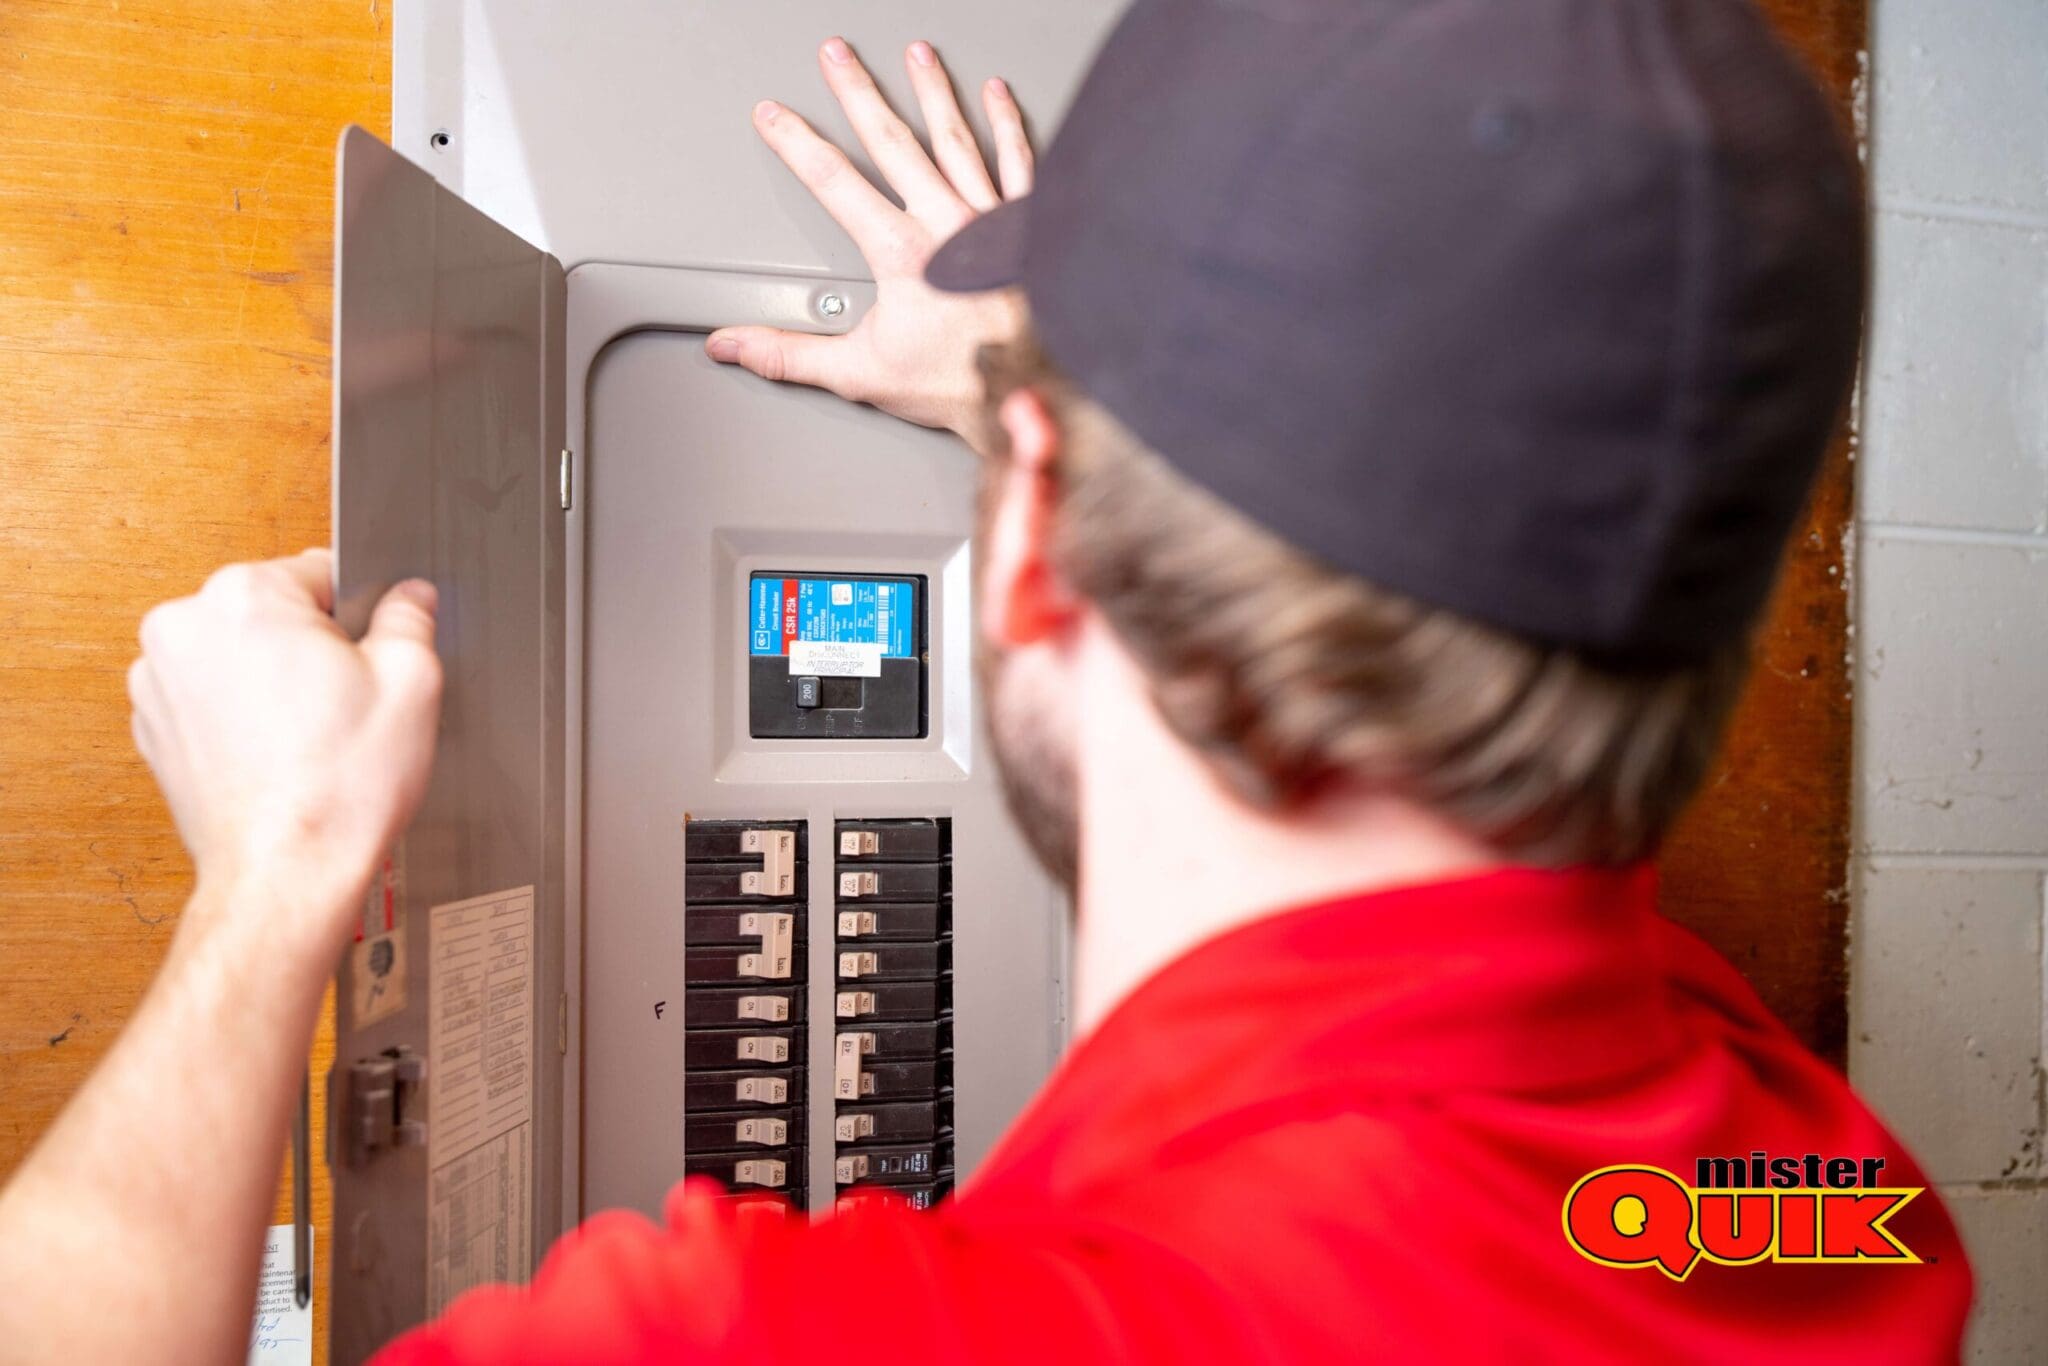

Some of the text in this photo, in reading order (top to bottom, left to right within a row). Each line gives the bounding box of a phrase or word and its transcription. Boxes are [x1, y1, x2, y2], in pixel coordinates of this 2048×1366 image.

[758, 582, 767, 629] Cutler-Hammer
[786, 596, 796, 634] CSR 25k
[803, 684, 812, 700] 200
[750, 835, 756, 846] ON
[749, 876, 756, 886] ON
[844, 880, 852, 892] 20
[747, 958, 753, 968] ON
[654, 1001, 666, 1020] F
[747, 1002, 754, 1011] ON
[747, 1042, 754, 1053] ON
[746, 1084, 753, 1094] ON
[842, 1082, 849, 1094] 40
[746, 1124, 752, 1135] ON
[744, 1166, 751, 1175] ON
